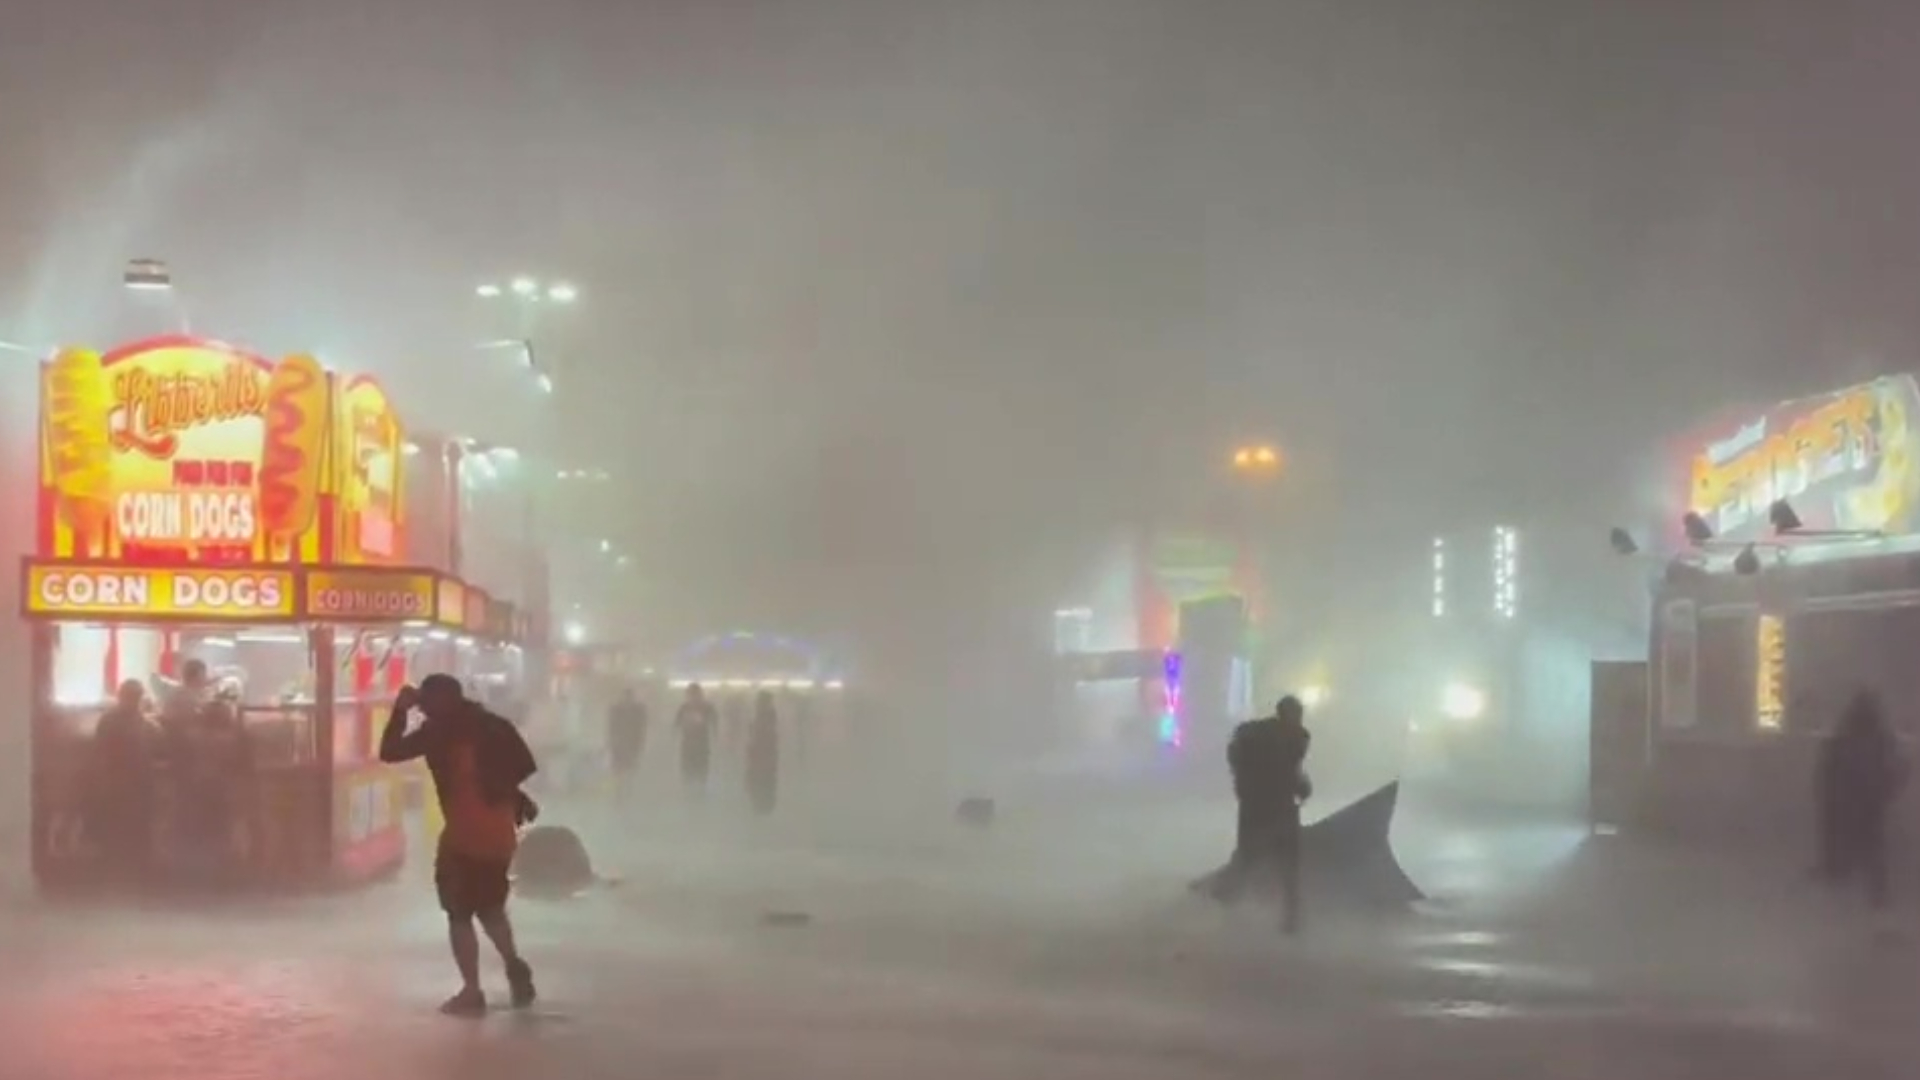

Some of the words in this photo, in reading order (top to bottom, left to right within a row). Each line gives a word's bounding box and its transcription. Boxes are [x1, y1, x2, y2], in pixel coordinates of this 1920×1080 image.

[118, 492, 182, 539] CORN
[190, 493, 254, 540] DOGS
[41, 573, 148, 605] CORN
[173, 575, 281, 607] DOGS
